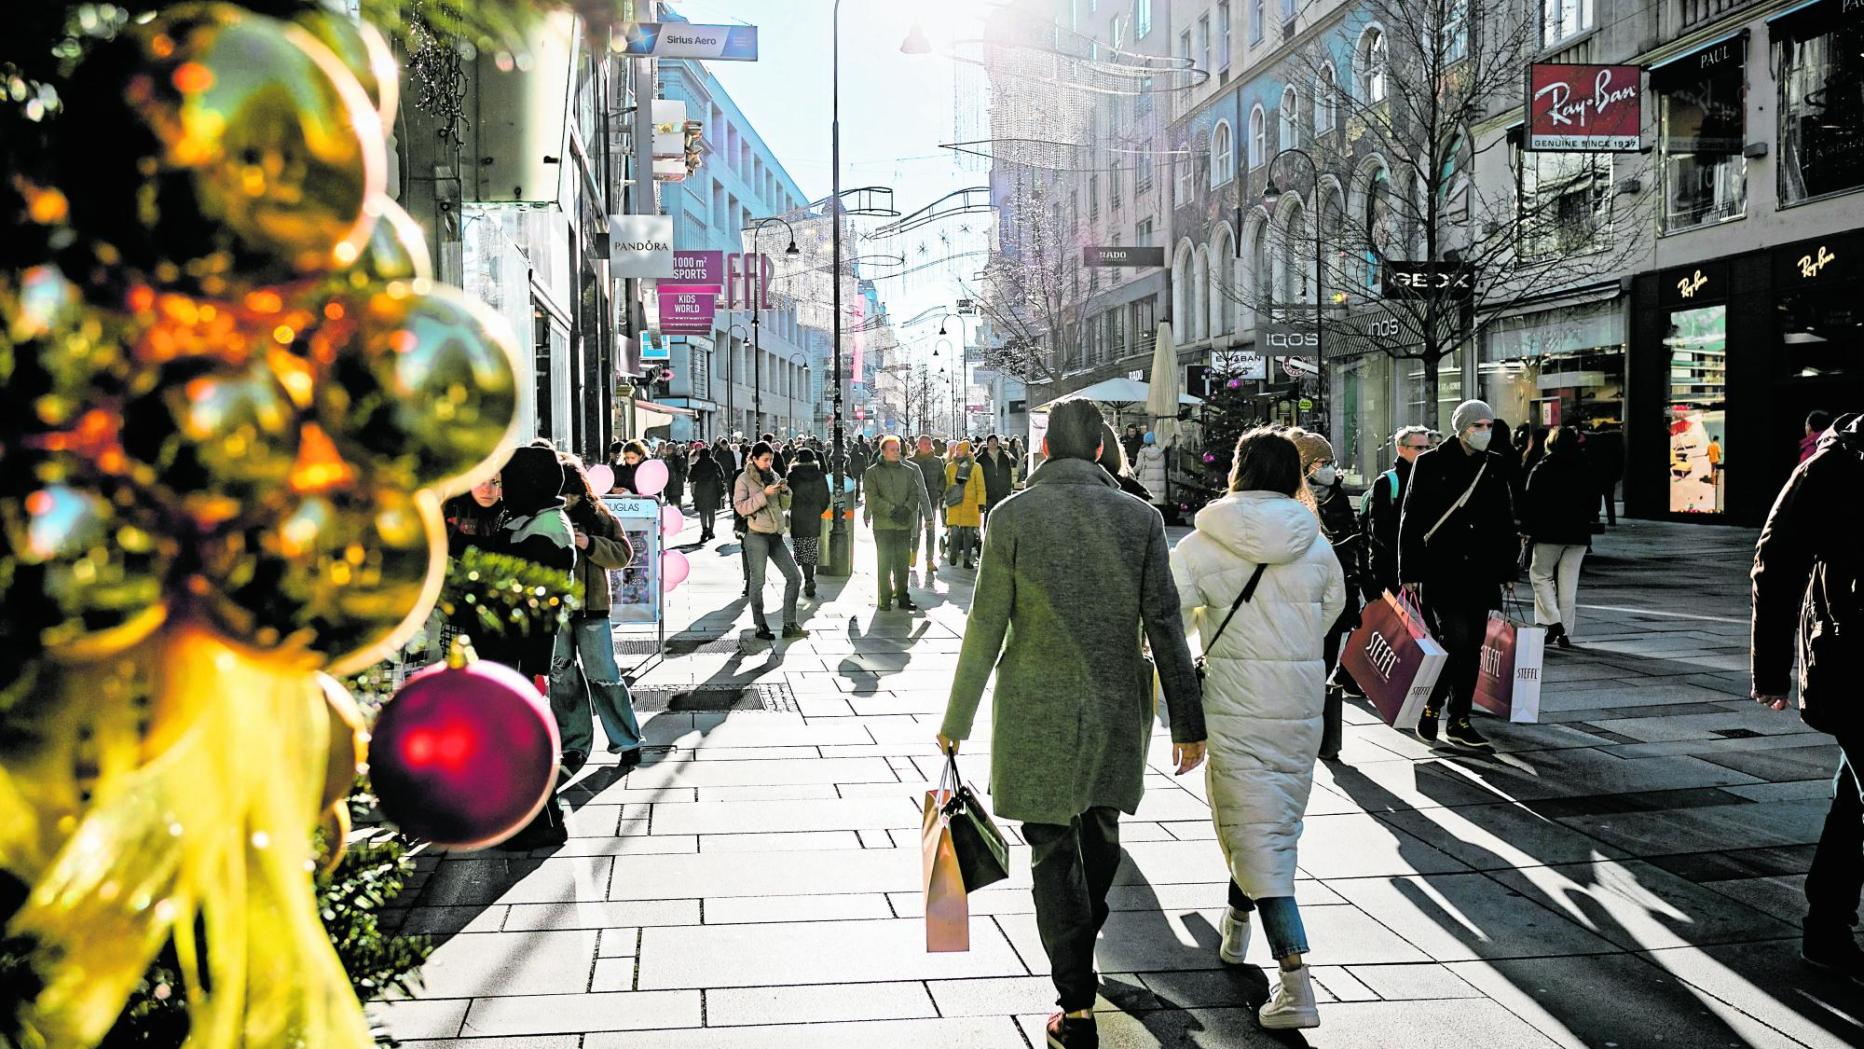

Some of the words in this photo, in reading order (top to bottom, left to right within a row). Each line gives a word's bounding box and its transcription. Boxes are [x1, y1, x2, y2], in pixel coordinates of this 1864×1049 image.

[667, 35, 693, 44] Sirius
[694, 36, 717, 45] Aero
[1701, 45, 1730, 69] PAUL
[1534, 140, 1578, 149] GENUINE
[1581, 139, 1611, 149] SINCE
[1613, 139, 1637, 149] 1937
[673, 257, 694, 267] 1000
[673, 268, 708, 280] SPORTS
[678, 295, 696, 304] KIDS
[674, 304, 700, 313] WORLD
[1266, 333, 1319, 348] IQOS
[1365, 631, 1397, 679] STEFFL
[1480, 645, 1501, 677] STEFFL
[1517, 667, 1538, 680] STEFFL
[1410, 686, 1431, 696] STEFFL
